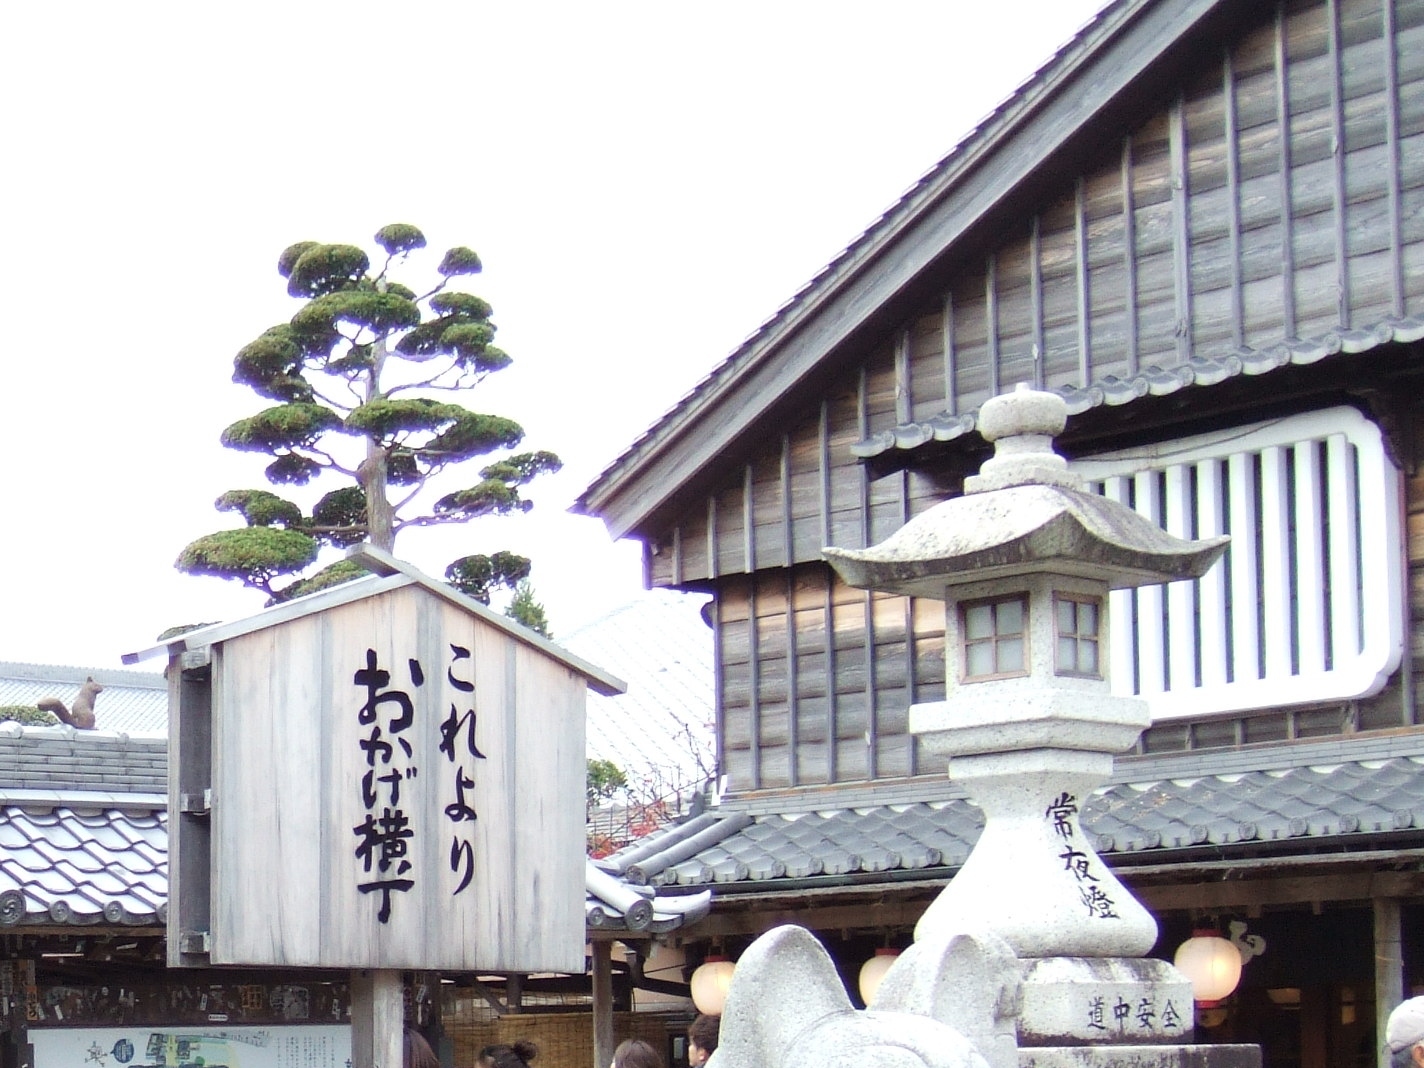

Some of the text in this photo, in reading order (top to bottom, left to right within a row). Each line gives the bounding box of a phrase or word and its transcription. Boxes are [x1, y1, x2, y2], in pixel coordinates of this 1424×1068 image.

[353, 648, 424, 924] おかげ横丁
[440, 643, 486, 895] これより
[1045, 792, 1120, 919] 常夜燈
[1087, 996, 1180, 1032] 道中安全
